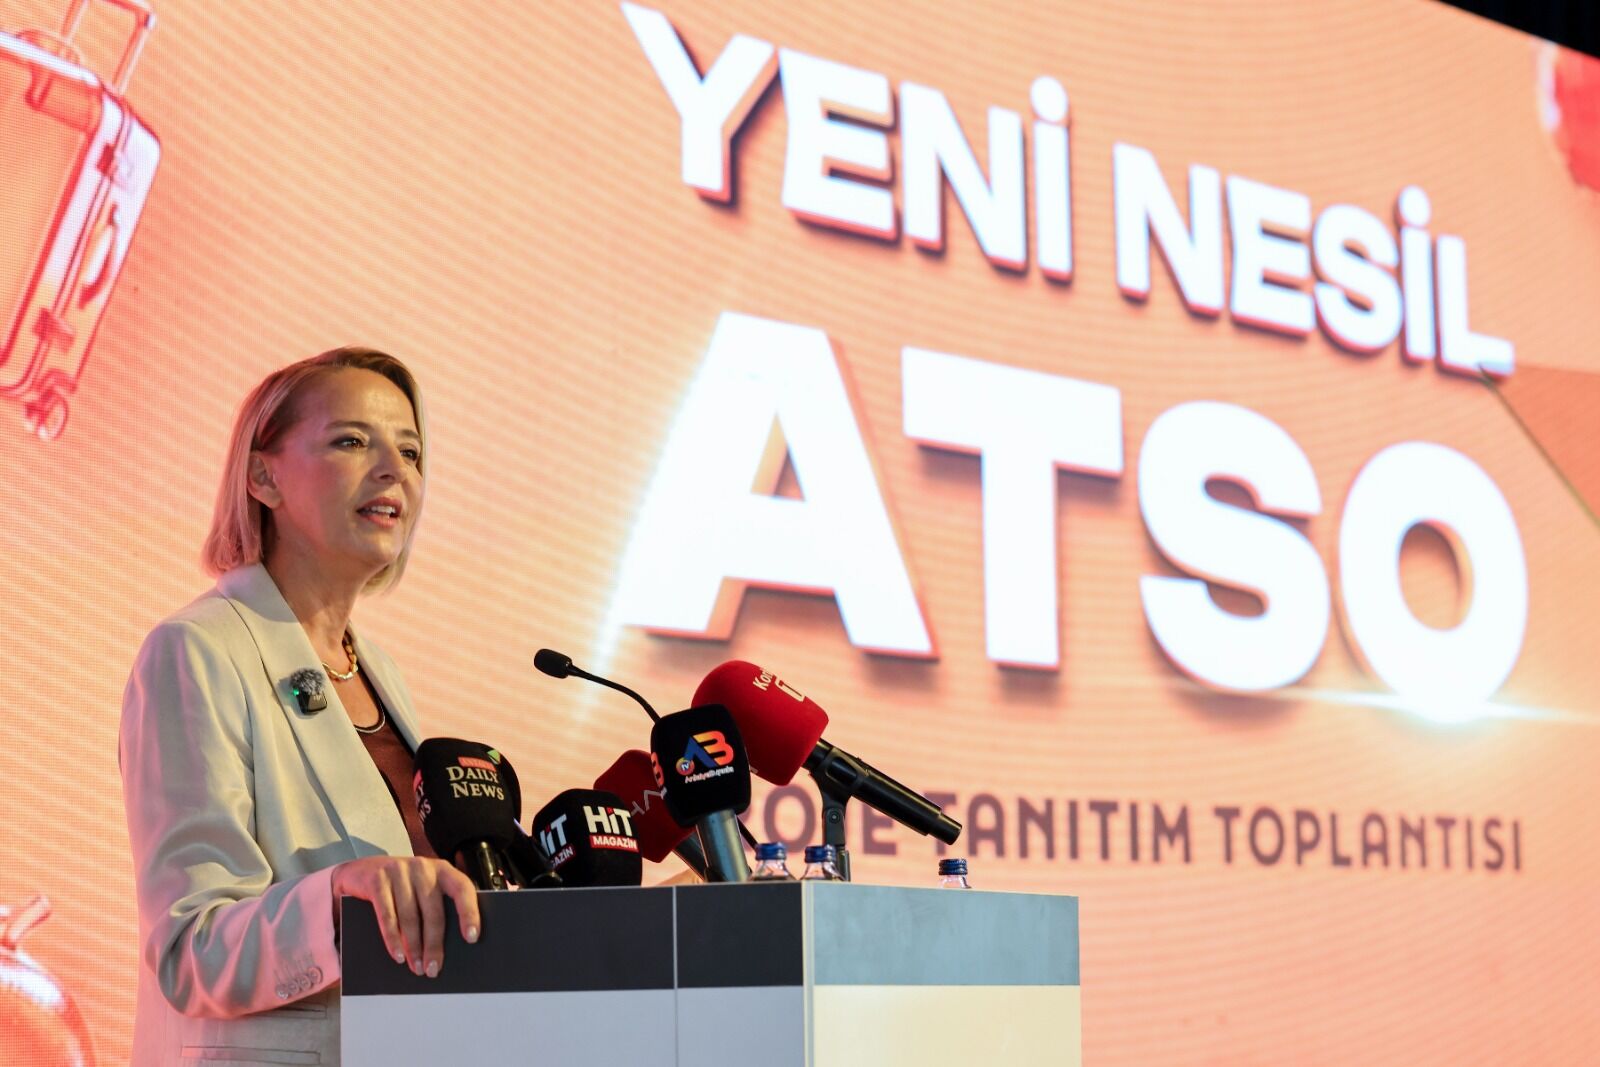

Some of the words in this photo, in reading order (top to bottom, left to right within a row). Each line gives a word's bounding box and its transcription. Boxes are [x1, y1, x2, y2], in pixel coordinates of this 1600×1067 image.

[617, 312, 1529, 722] ATSO
[446, 765, 499, 784] DAILY
[450, 781, 504, 801] NEWS
[1214, 806, 1521, 871] TOPLANTISI
